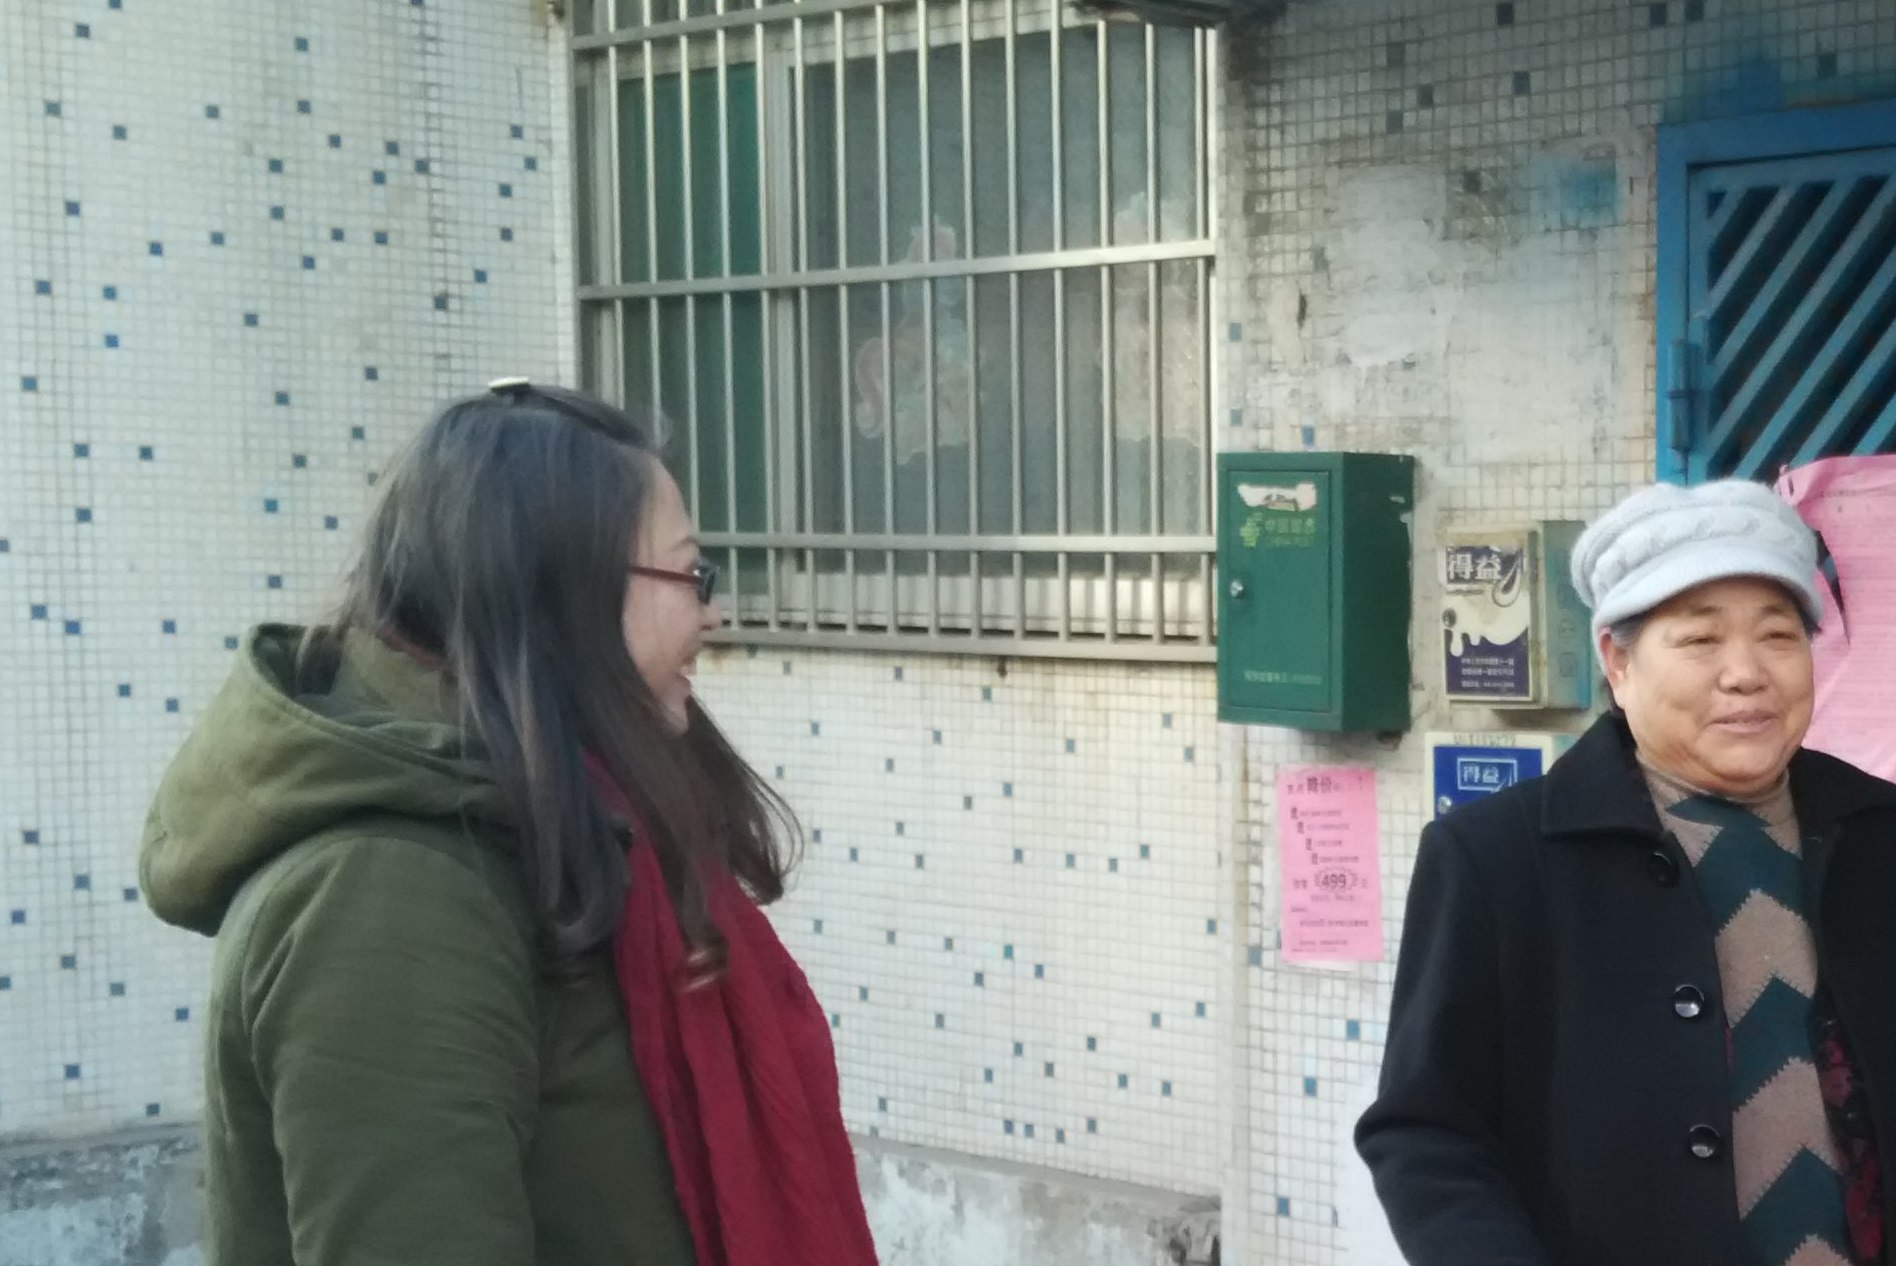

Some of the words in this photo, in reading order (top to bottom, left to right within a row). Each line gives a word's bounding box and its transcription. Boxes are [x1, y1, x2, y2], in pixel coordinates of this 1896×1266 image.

[1447, 553, 1502, 580] 得益
[1463, 765, 1499, 784] 得益
[1321, 873, 1346, 889] 499
